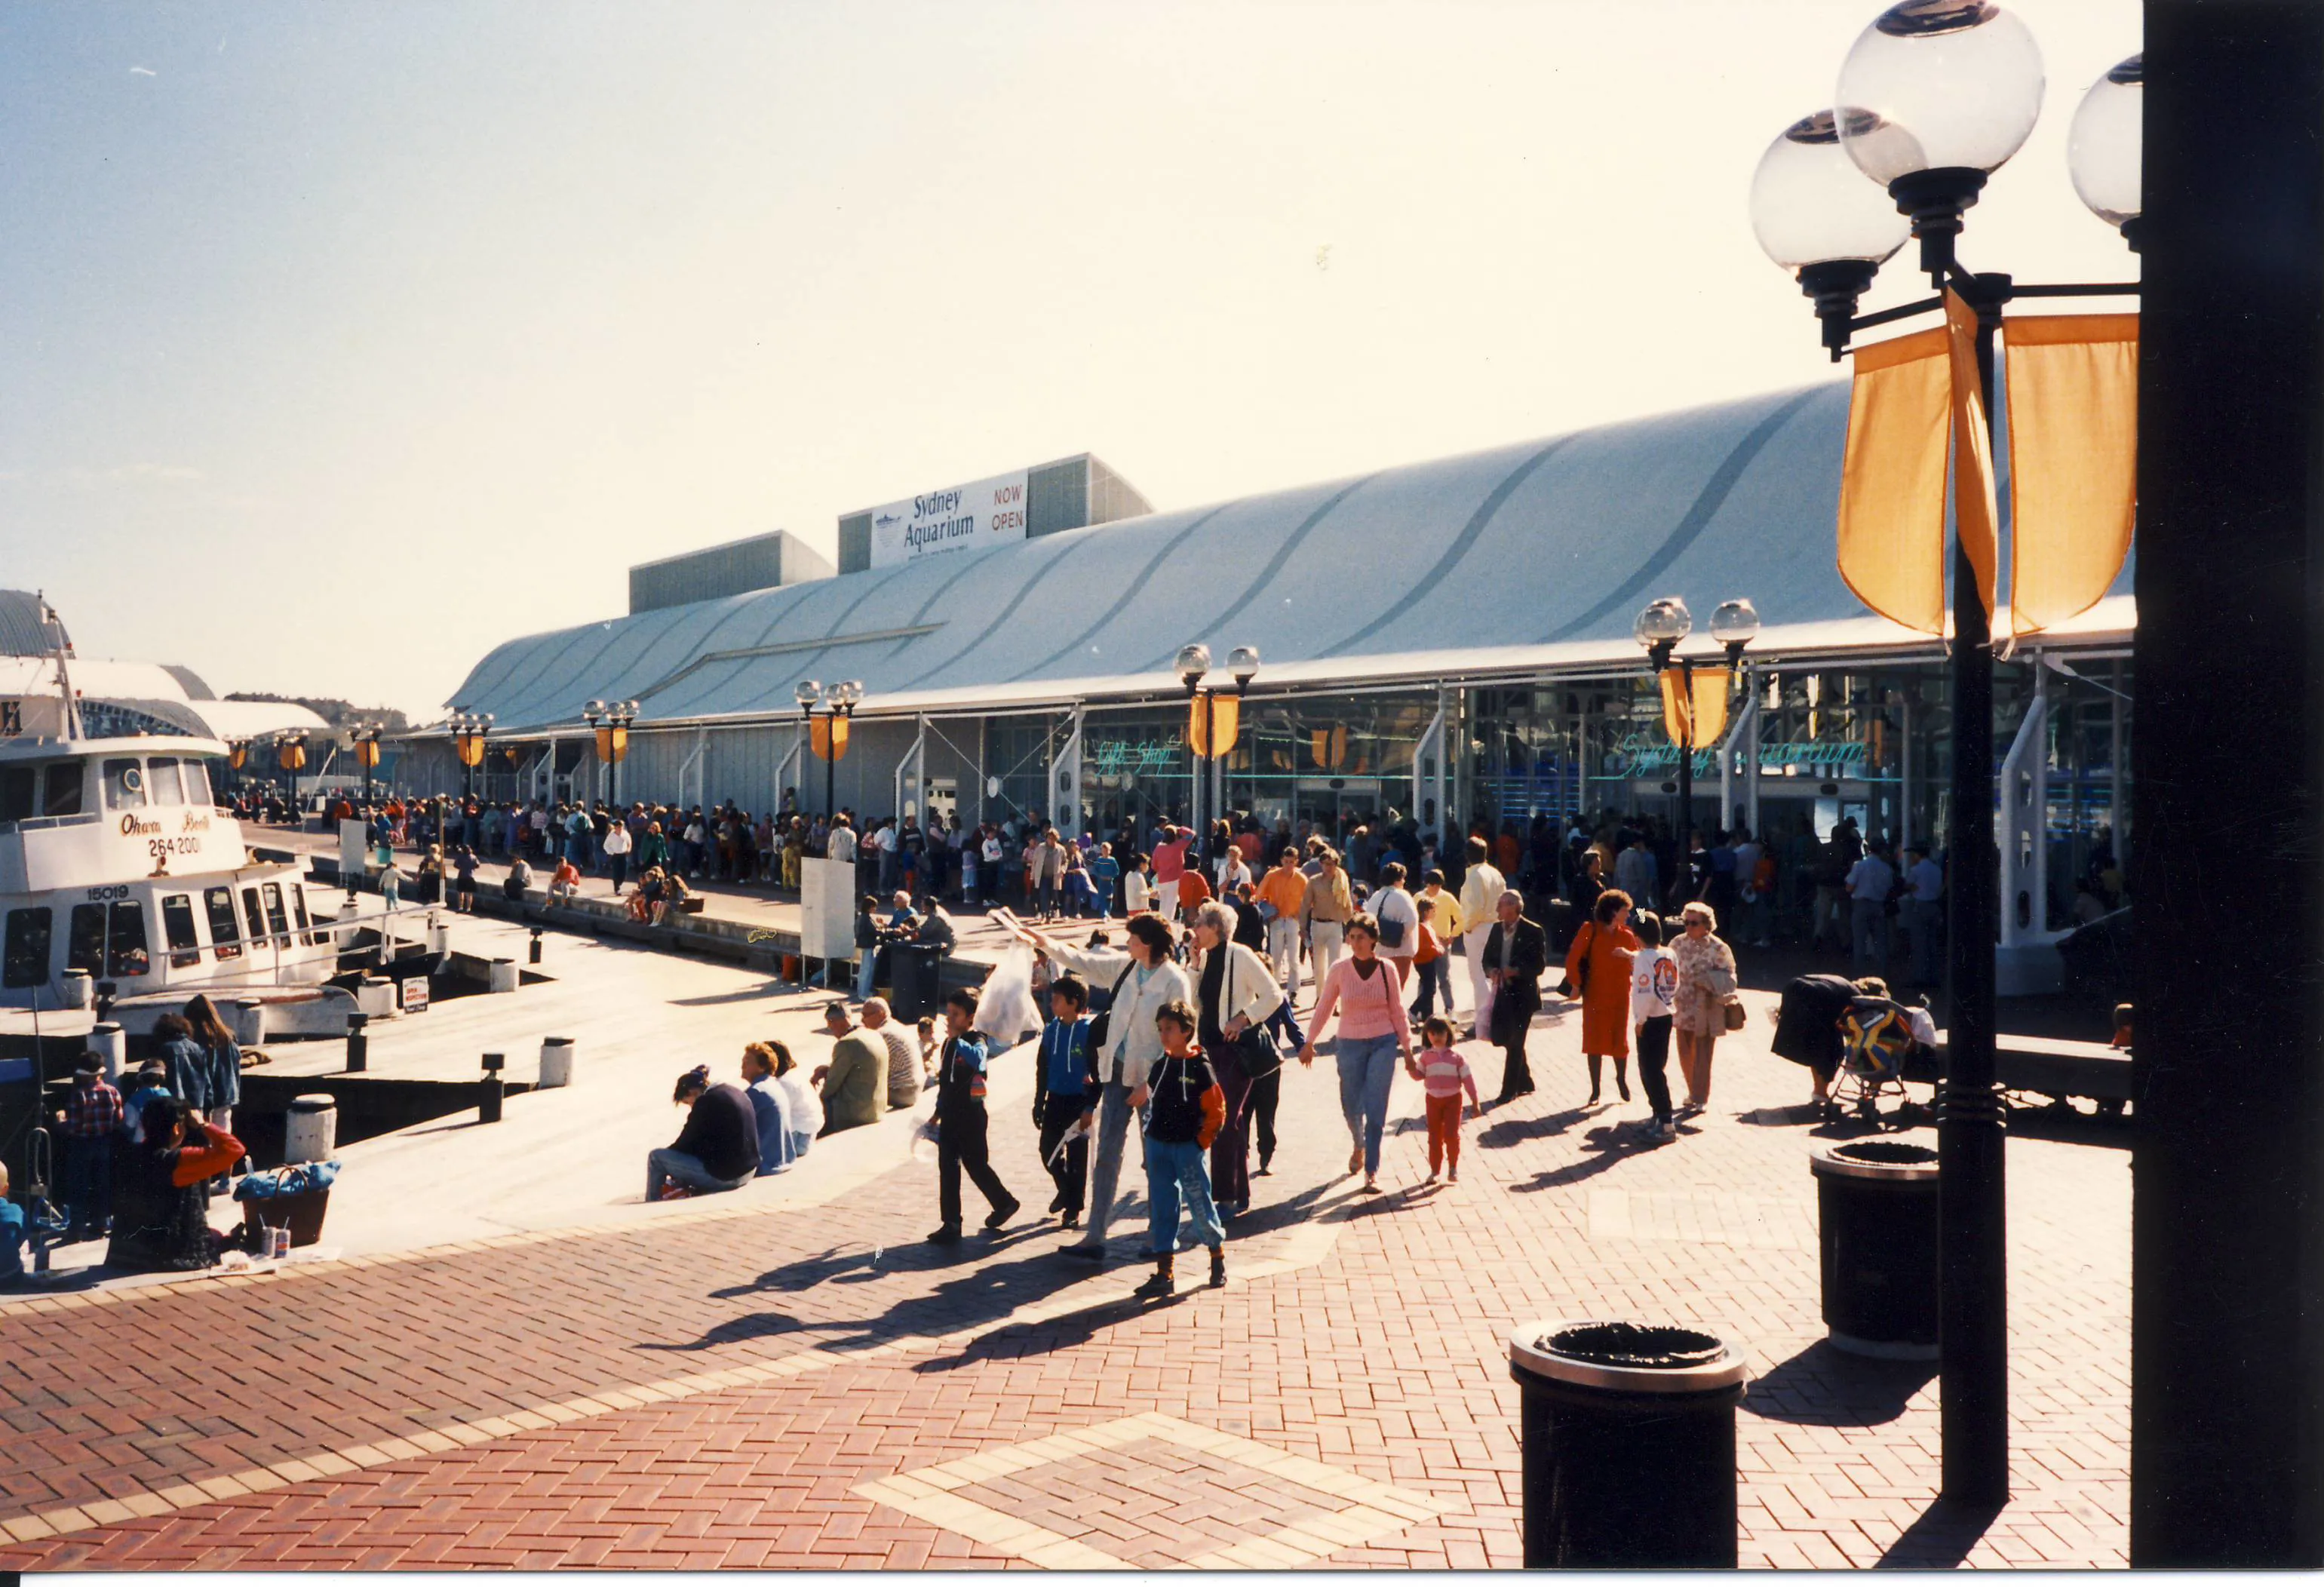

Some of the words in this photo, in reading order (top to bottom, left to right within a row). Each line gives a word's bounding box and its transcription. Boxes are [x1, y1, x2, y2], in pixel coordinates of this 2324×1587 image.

[913, 490, 962, 522] Sydney
[994, 484, 1023, 505] NOW
[904, 514, 974, 552] Aquarium
[992, 511, 1024, 531] OPEN
[1134, 741, 1170, 776] Shop
[1622, 733, 1713, 778] Sydny
[87, 885, 129, 901] 15019
